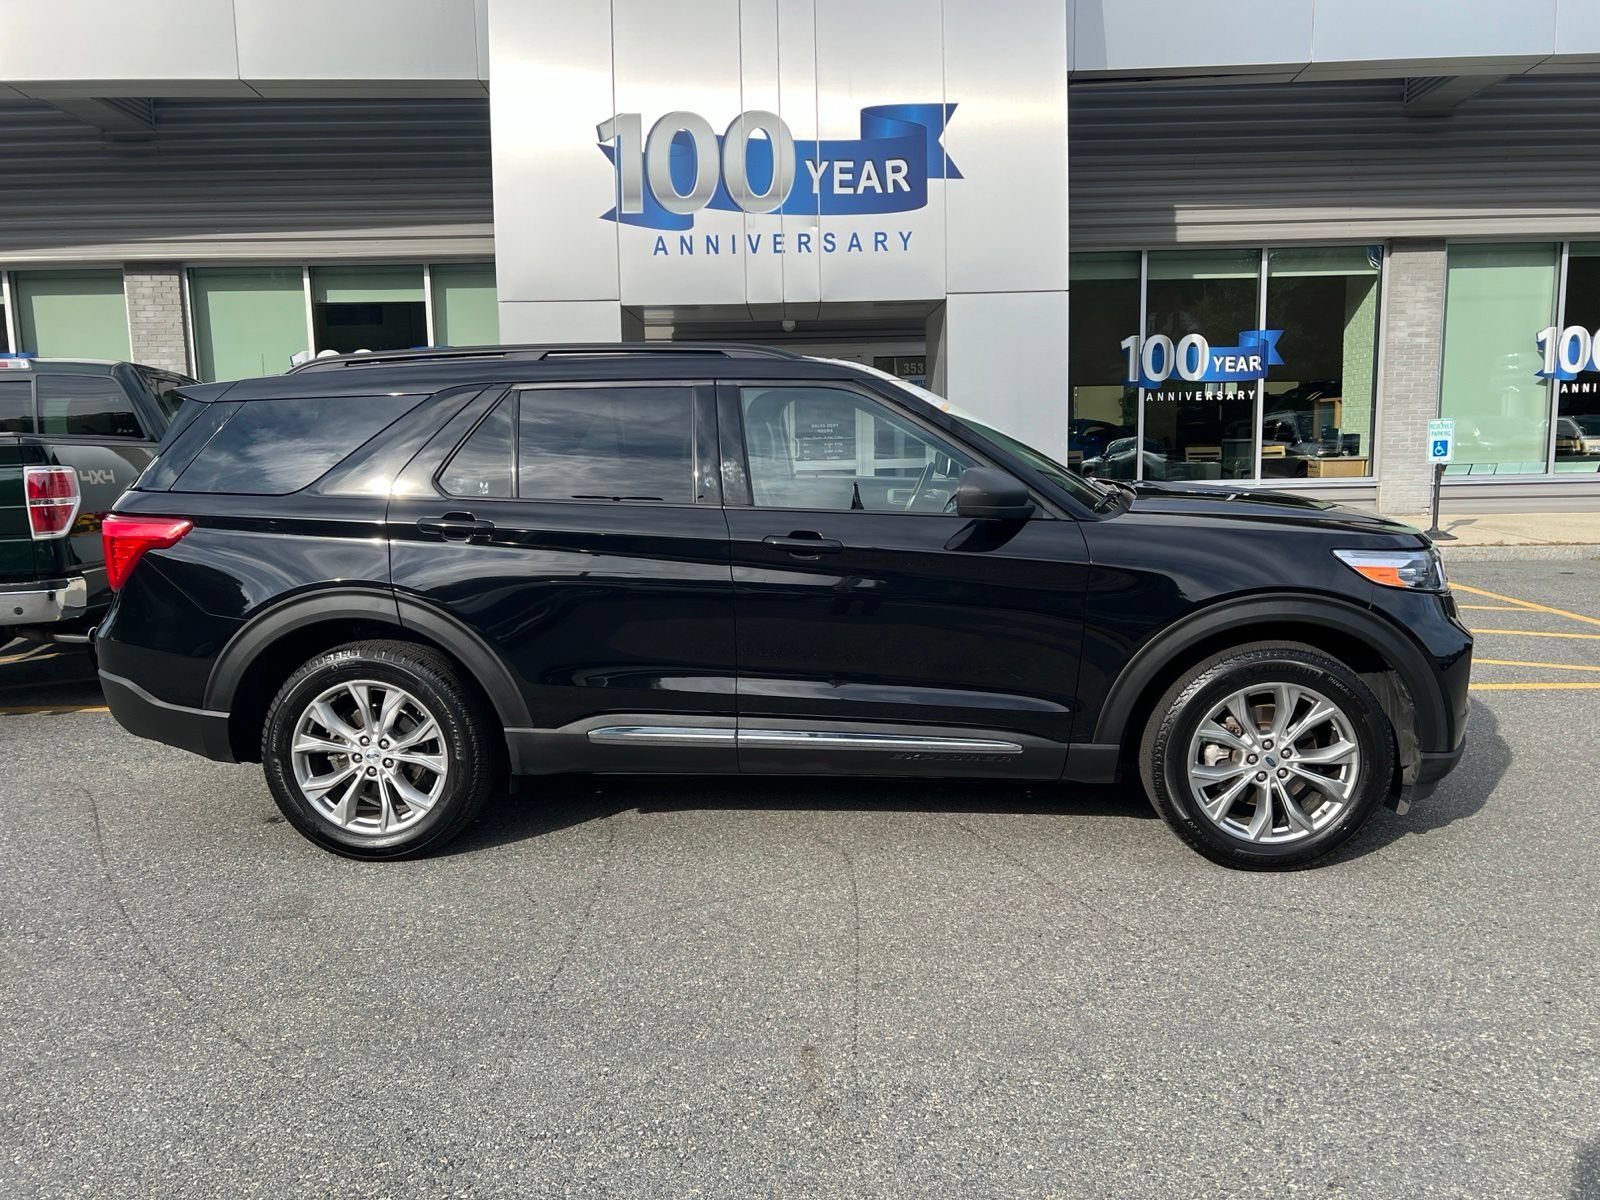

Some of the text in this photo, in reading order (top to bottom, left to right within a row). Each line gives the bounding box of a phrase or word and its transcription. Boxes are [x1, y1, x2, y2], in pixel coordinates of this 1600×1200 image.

[595, 110, 912, 215] 100 YEAR
[653, 231, 913, 256] ANNIVERSARY
[1120, 333, 1262, 382] 100 YEAR
[1536, 325, 1600, 374] 10
[903, 362, 925, 375] 353
[1146, 390, 1256, 402] ANNIVERSARY
